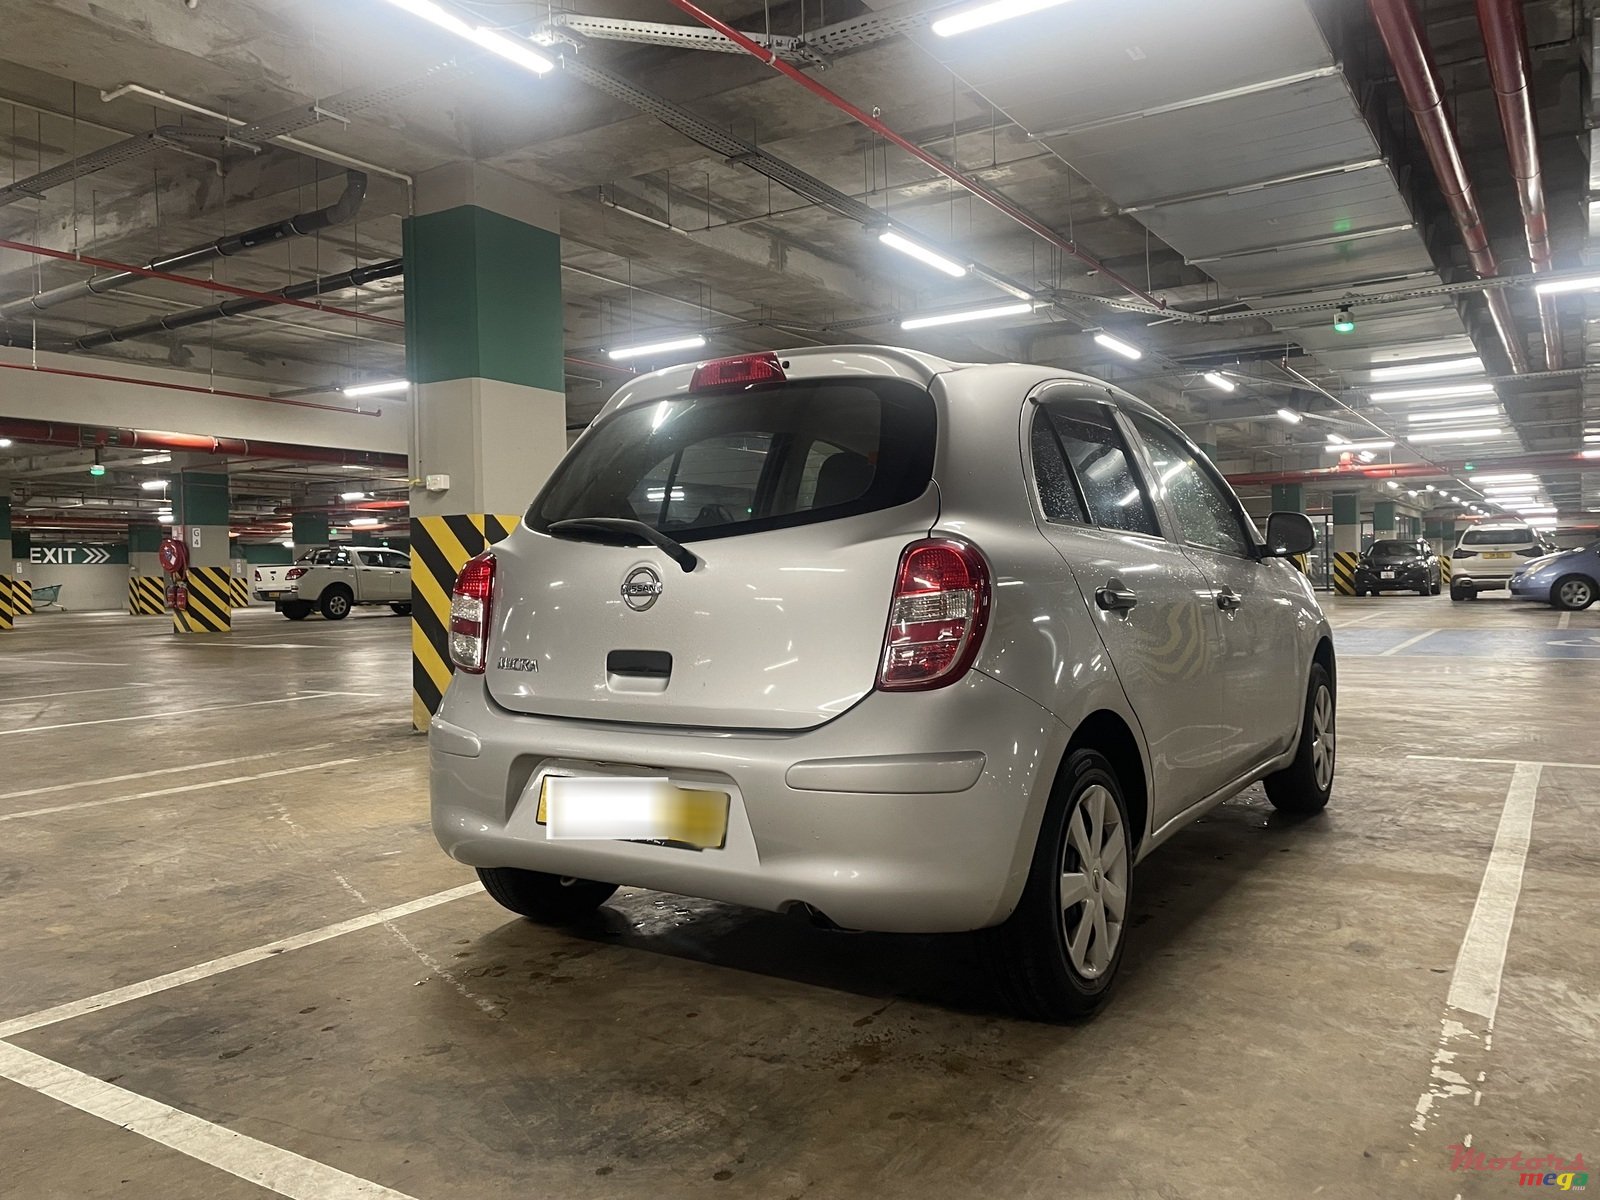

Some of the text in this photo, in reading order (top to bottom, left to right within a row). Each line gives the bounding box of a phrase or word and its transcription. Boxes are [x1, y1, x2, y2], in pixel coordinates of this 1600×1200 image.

[193, 529, 200, 537] G
[30, 547, 76, 564] EXIT
[624, 584, 656, 593] NISSAN
